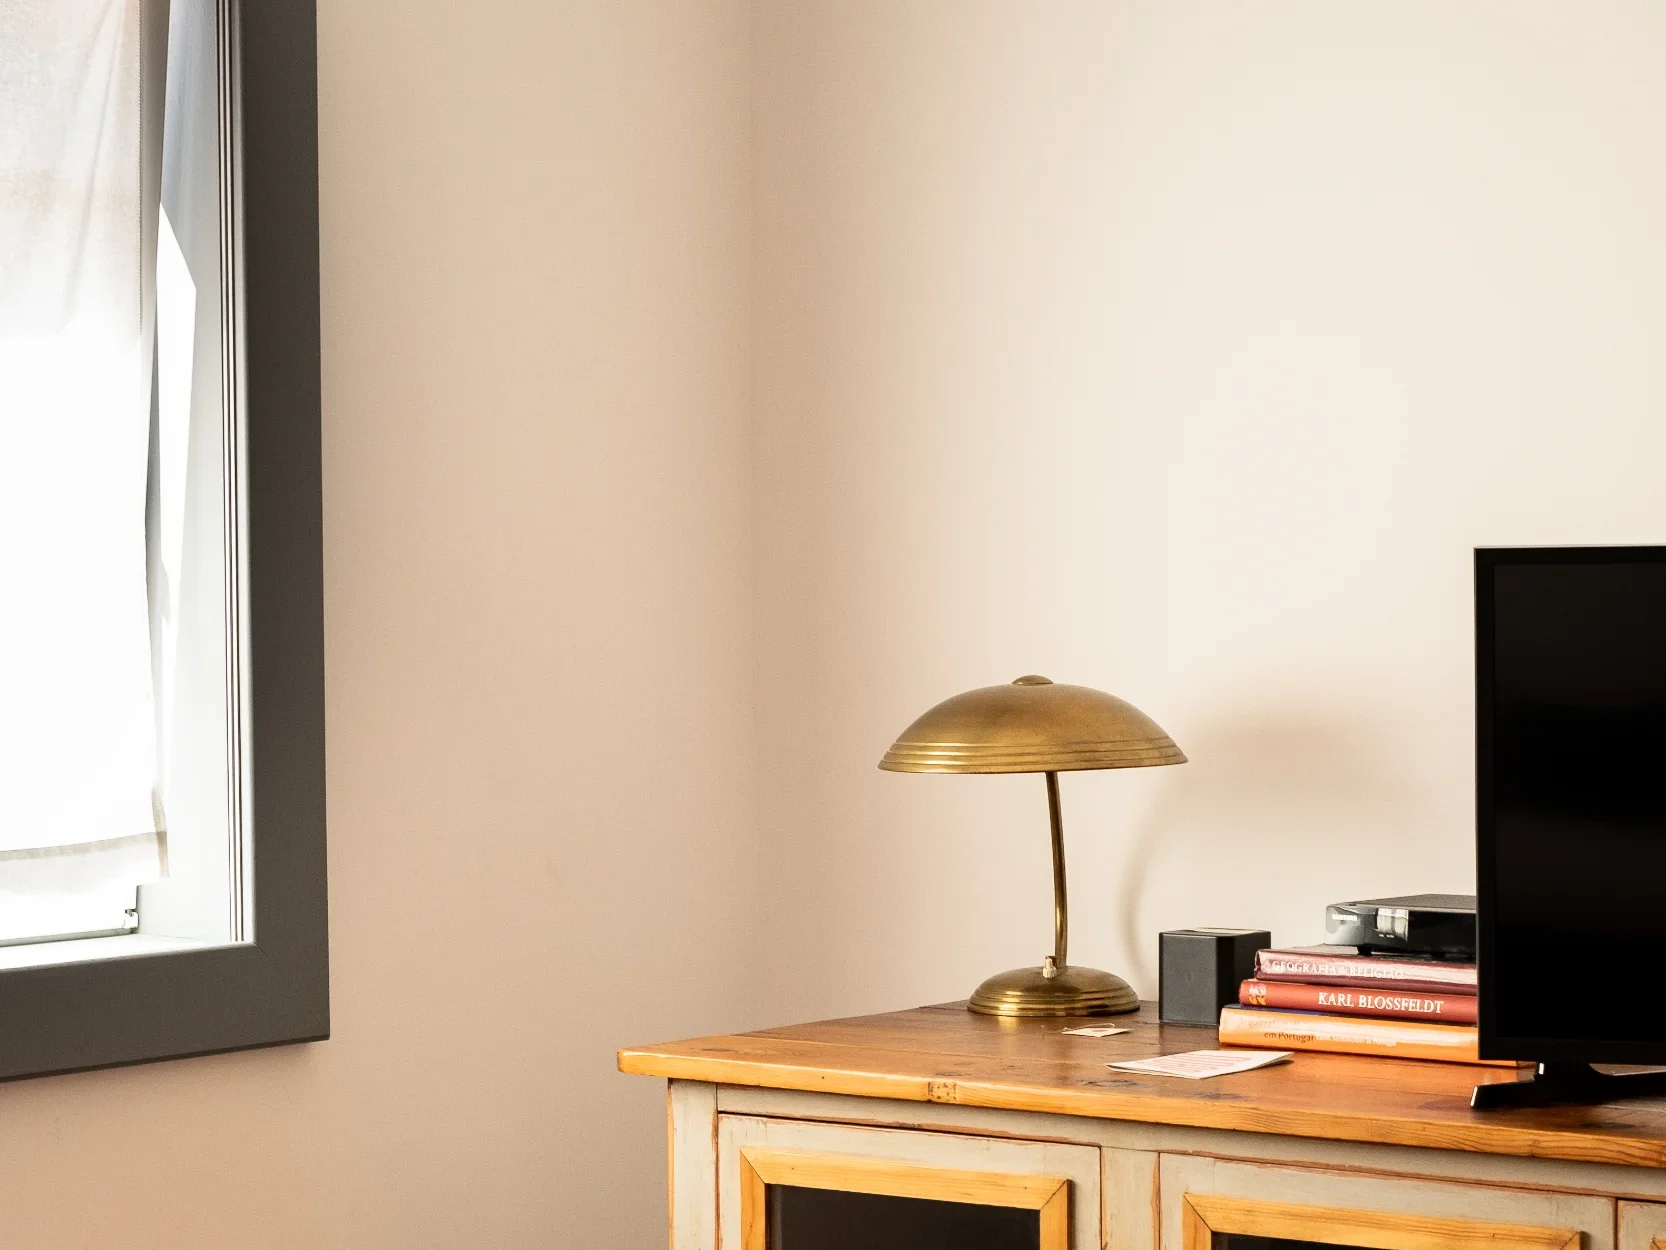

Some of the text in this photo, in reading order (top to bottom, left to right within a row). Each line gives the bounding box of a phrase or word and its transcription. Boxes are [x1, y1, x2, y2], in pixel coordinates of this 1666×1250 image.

[1318, 992, 1444, 1014] KARL BLOSSFELDT
[1264, 1032, 1277, 1040] em
[1279, 1032, 1315, 1043] Portugal
